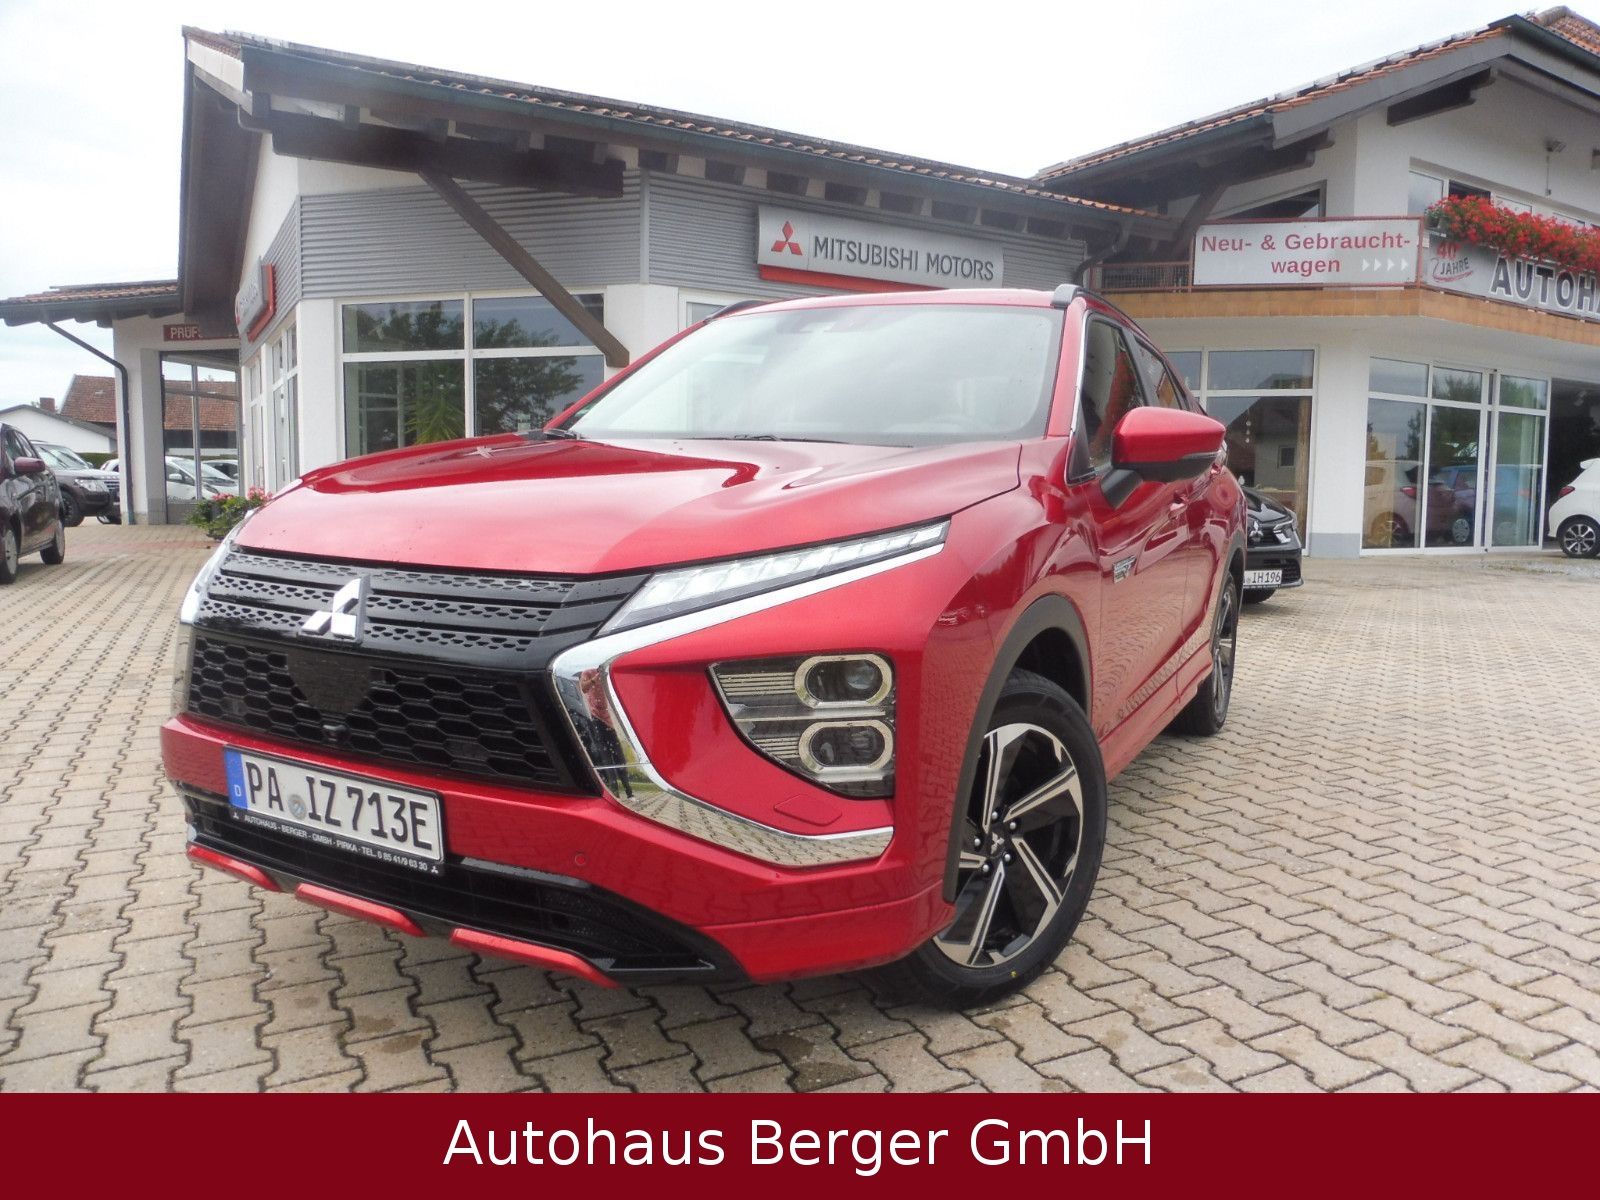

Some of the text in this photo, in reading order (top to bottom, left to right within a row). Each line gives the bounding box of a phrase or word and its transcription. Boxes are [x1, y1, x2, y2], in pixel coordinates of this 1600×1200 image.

[1202, 232, 1411, 252] Neu- & Gebraucht-
[813, 235, 994, 281] MITSUBISHI MOTORS
[1271, 258, 1341, 277] wagen
[1440, 257, 1470, 275] JAHRE
[1490, 254, 1600, 315] AUTOH
[245, 761, 284, 811] PA
[244, 815, 277, 830] AUTOHAUS
[281, 825, 307, 838] BERGER
